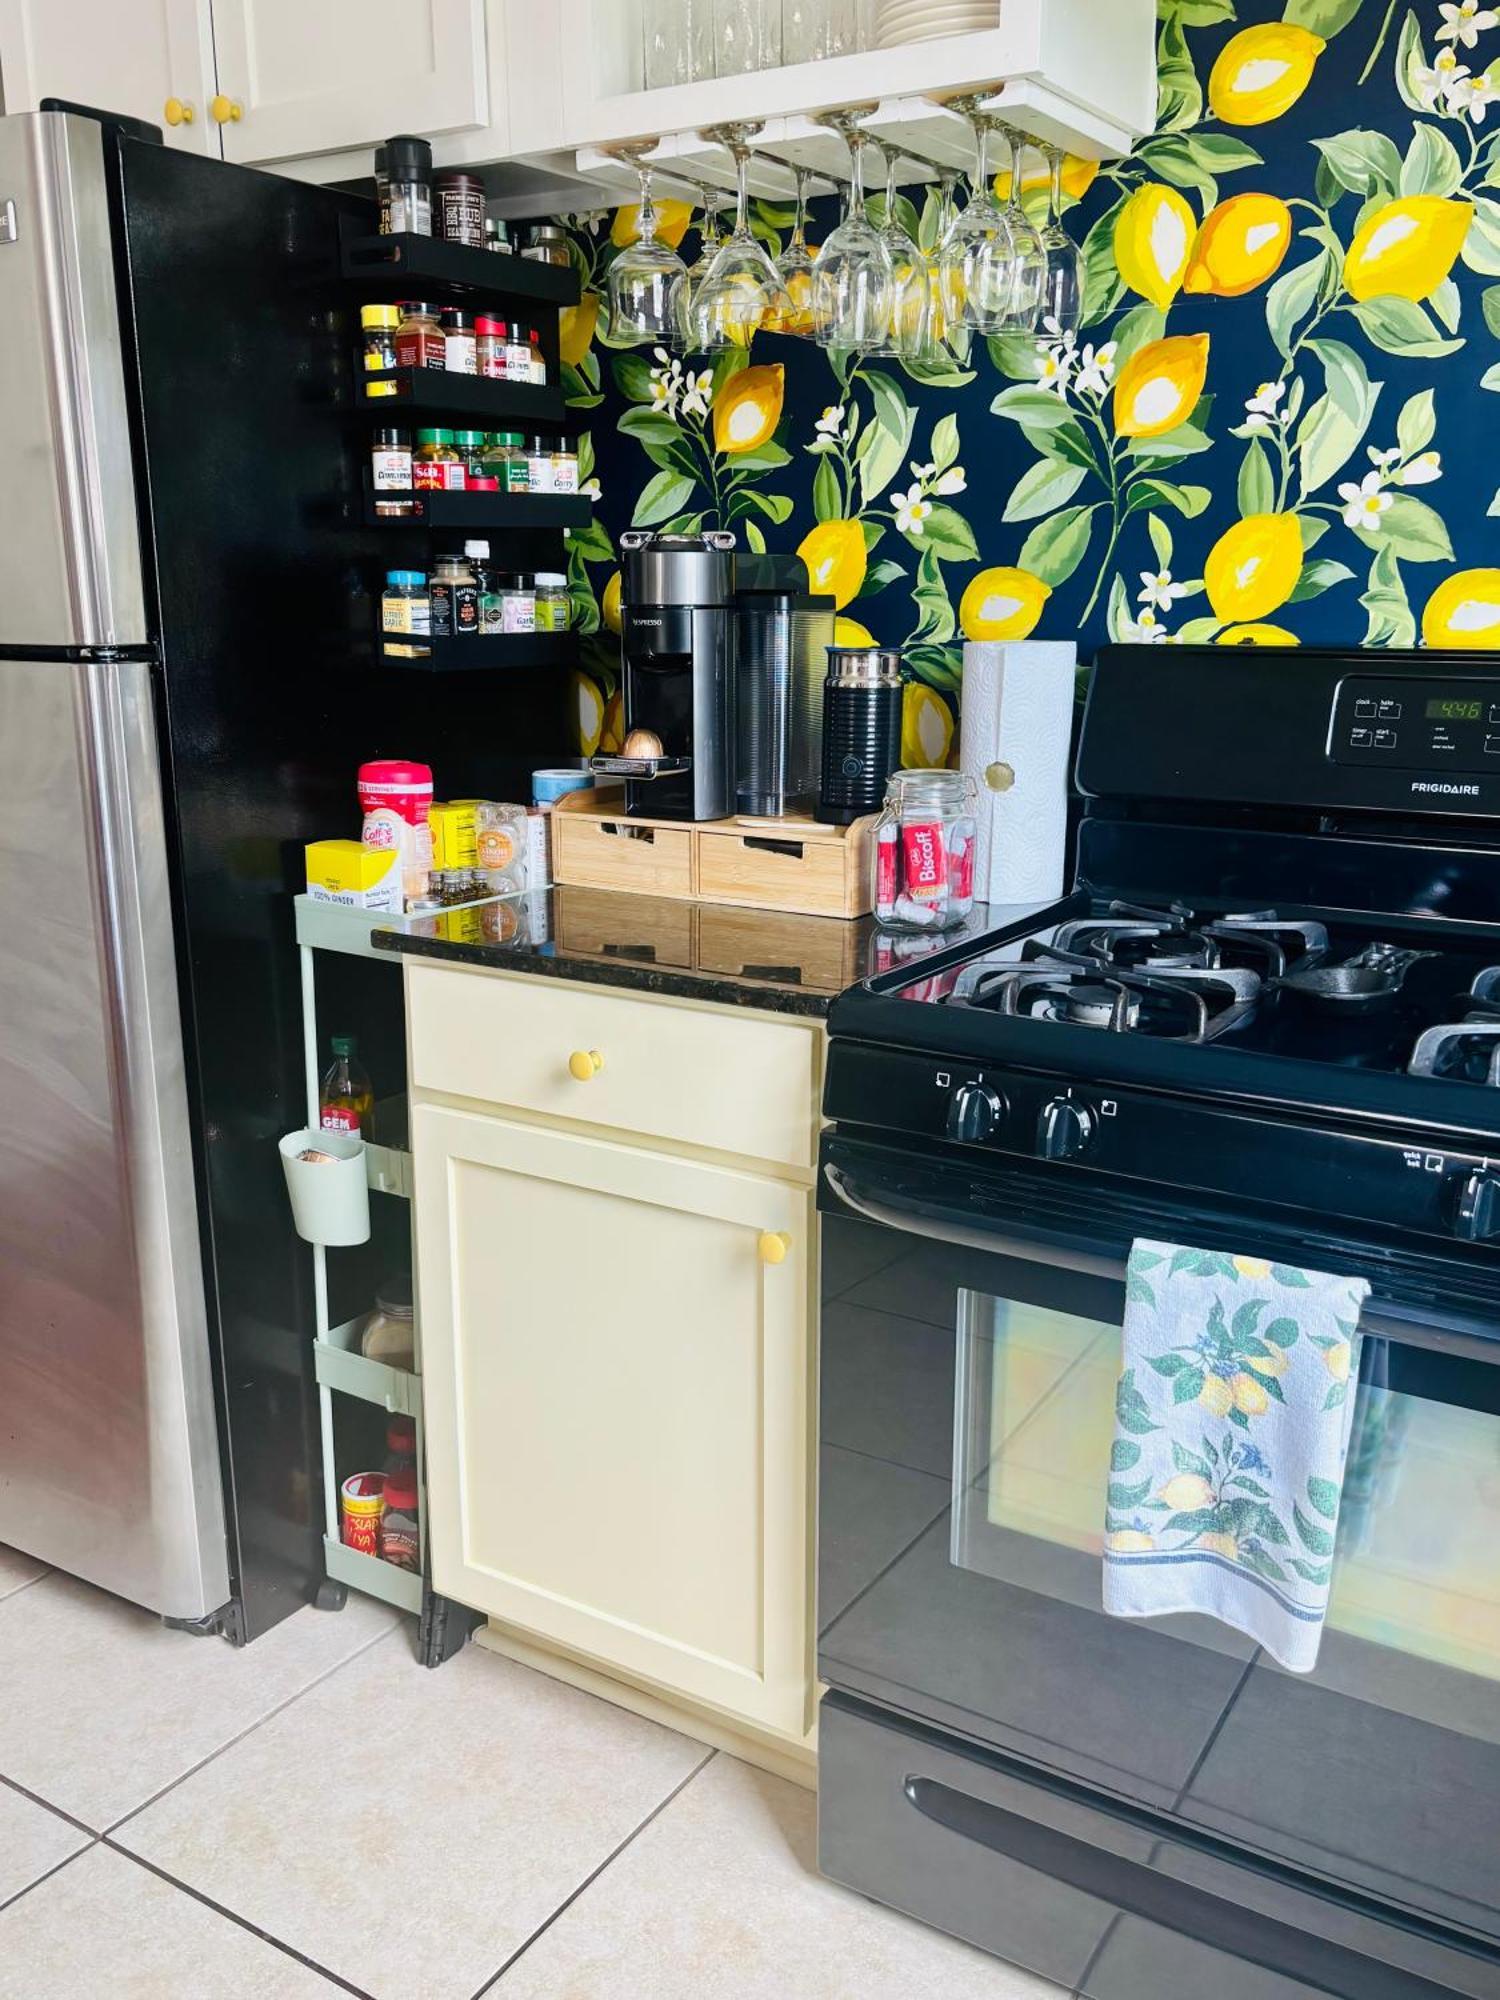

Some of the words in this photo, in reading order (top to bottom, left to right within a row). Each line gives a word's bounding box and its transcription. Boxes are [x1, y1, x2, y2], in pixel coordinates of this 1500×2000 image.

[446, 206, 458, 226] BBQ
[459, 207, 481, 222] RUB
[632, 618, 663, 626] NESPRESSO
[1411, 782, 1480, 795] FRIGIDAIRE
[915, 831, 935, 882] Biscoff
[322, 1116, 350, 1130] GEM
[357, 1534, 371, 1547] YA
